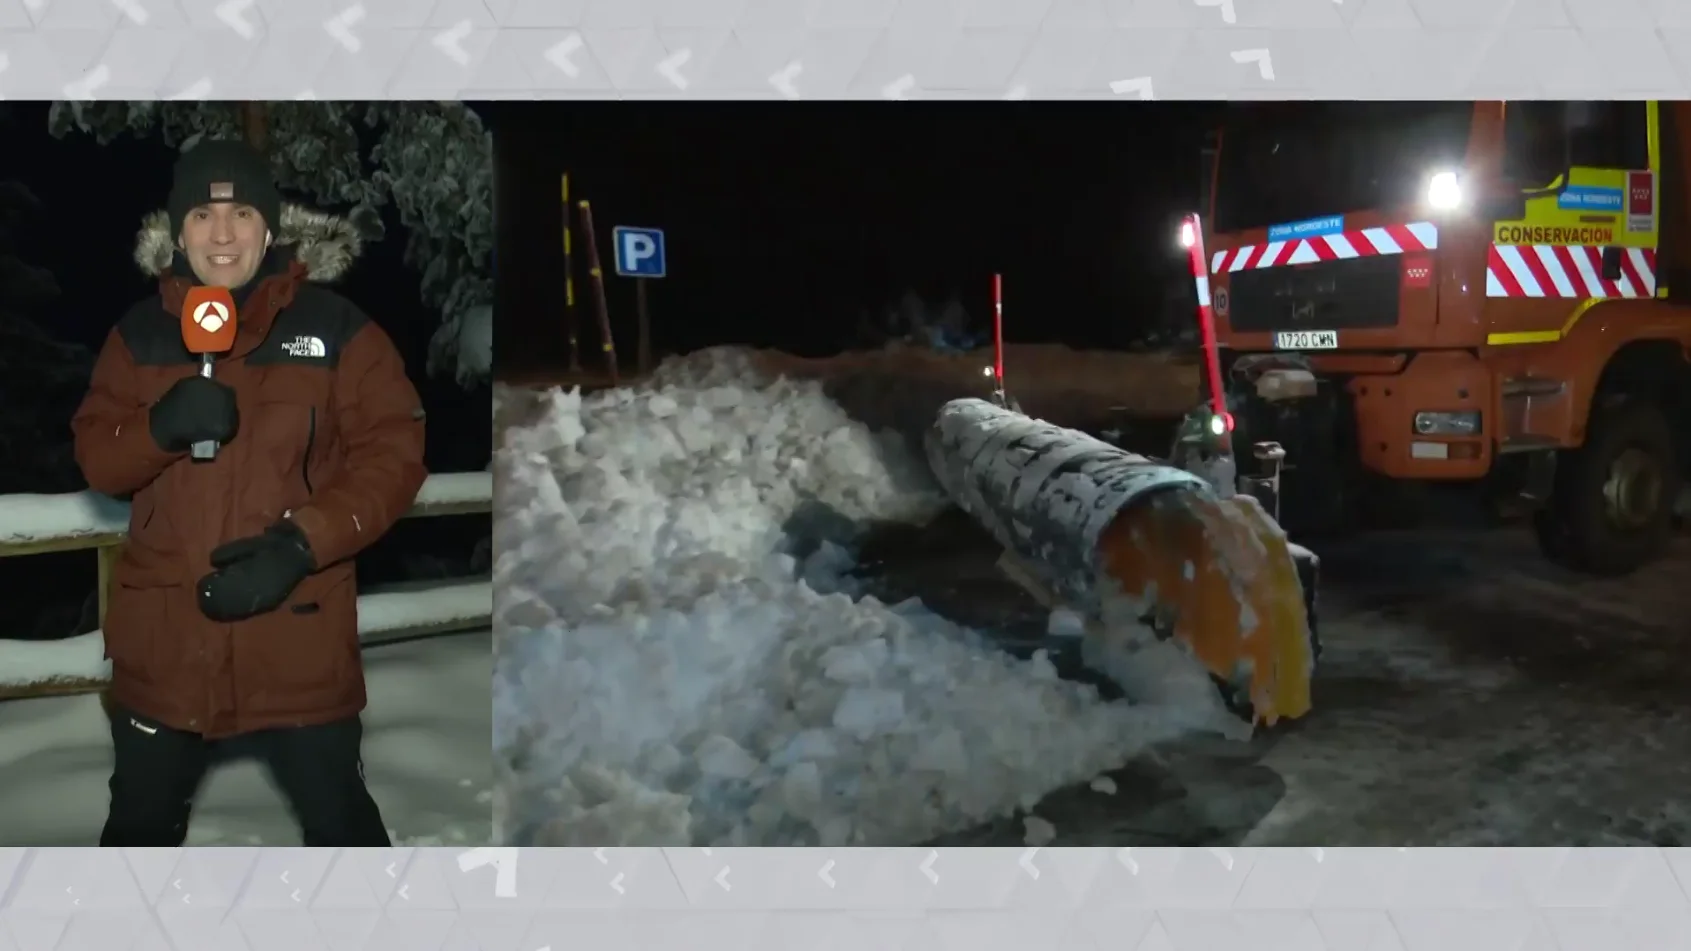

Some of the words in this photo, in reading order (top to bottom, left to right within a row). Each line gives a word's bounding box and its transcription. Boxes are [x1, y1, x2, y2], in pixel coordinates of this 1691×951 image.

[1498, 225, 1612, 243] CONSERVACION
[624, 233, 656, 271] P
[281, 342, 311, 350] NORTH
[1281, 333, 1308, 347] 1720
[289, 349, 311, 357] FACE
